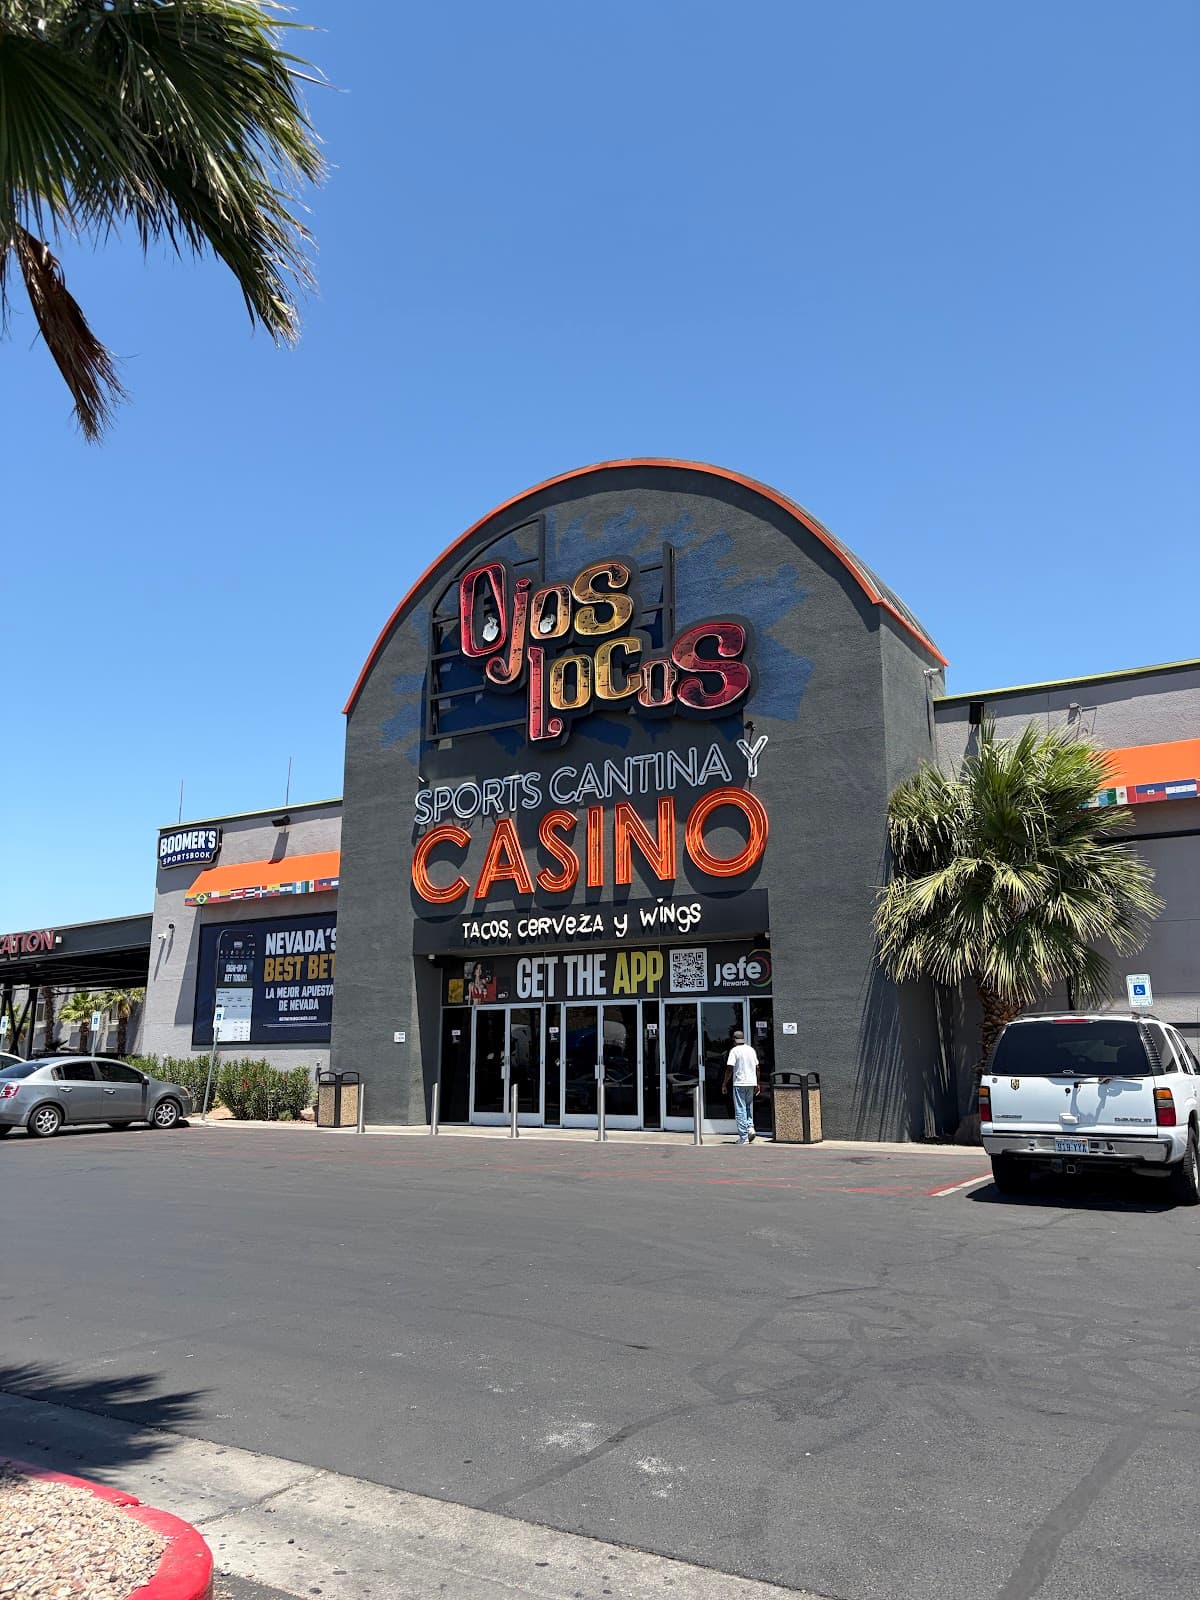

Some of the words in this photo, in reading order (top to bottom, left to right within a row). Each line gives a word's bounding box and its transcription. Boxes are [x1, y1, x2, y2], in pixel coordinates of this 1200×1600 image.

[414, 772, 542, 826] SPORTS
[549, 743, 732, 804] CANTINA
[736, 735, 769, 778] Y
[160, 830, 216, 857] BOOMER'S
[411, 785, 770, 905] CASINO
[162, 851, 210, 865] SPORTSBOOK
[0, 929, 55, 955] ATION
[462, 921, 512, 940] TACOS,
[263, 955, 305, 983] BEST
[516, 956, 559, 999] GET
[563, 953, 607, 997] THE
[612, 950, 664, 995] APP
[713, 956, 762, 987] jefe
[265, 987, 275, 999] LA
[276, 986, 300, 999] MEJOR
[301, 983, 334, 998] APUESTA
[722, 979, 750, 988] Rewards
[278, 1000, 288, 1011] DE
[289, 998, 320, 1011] NEVADA
